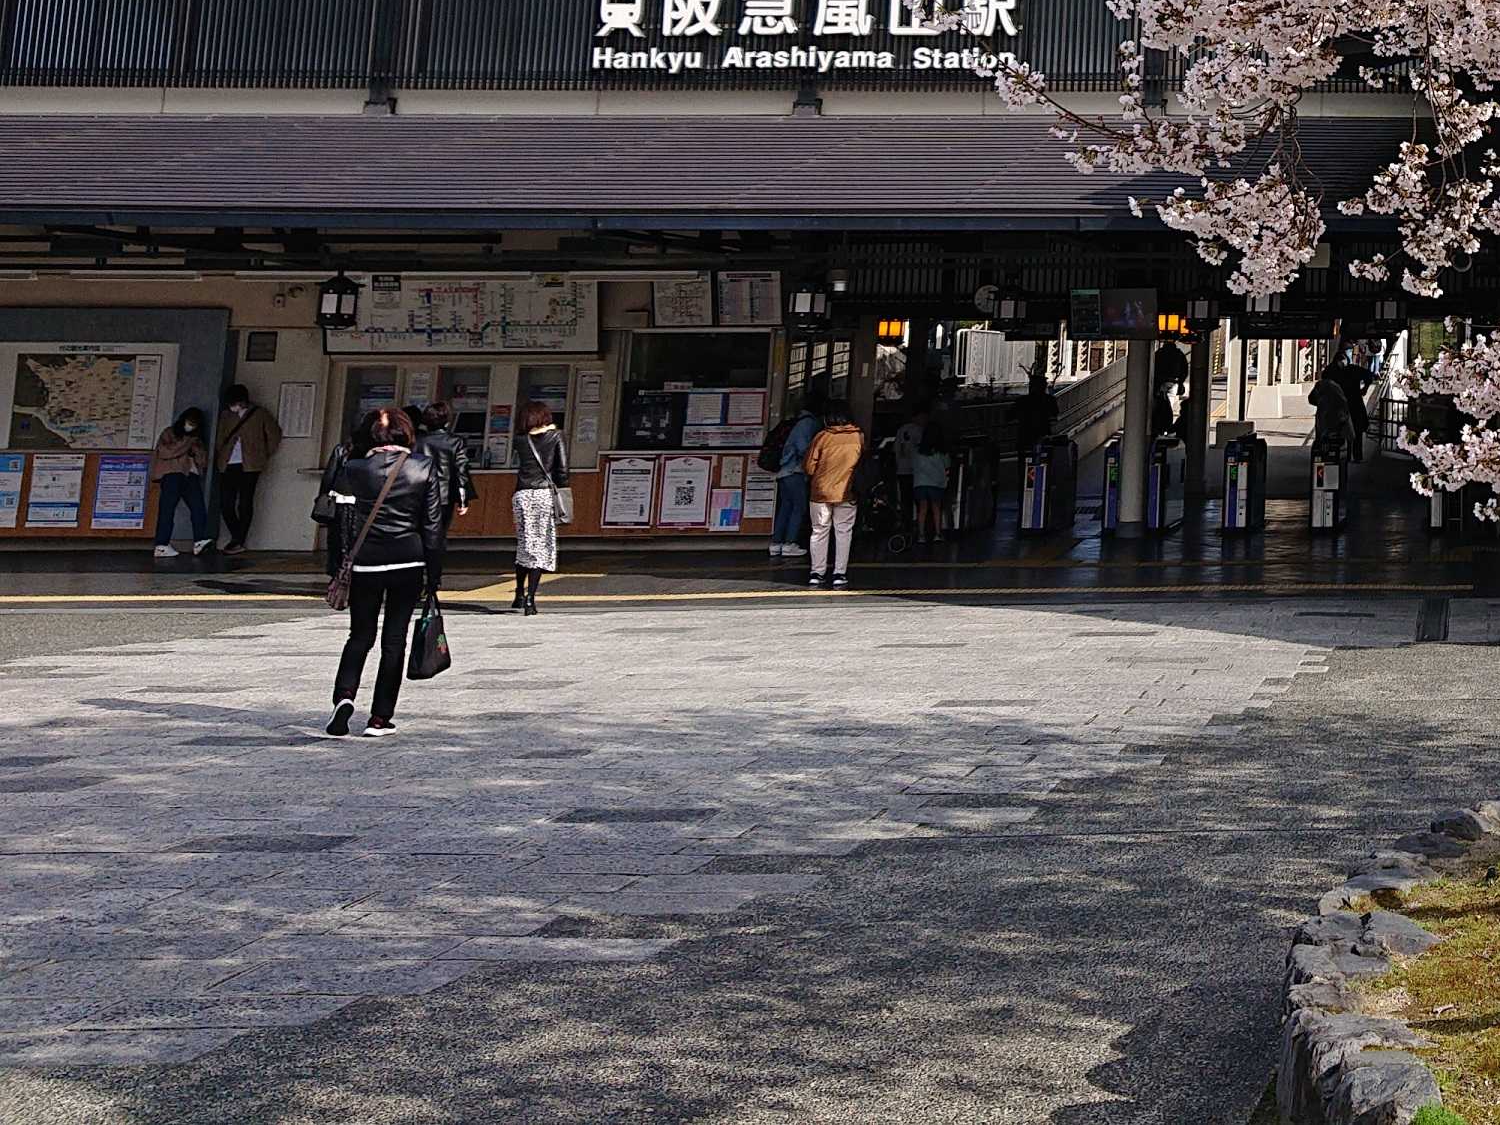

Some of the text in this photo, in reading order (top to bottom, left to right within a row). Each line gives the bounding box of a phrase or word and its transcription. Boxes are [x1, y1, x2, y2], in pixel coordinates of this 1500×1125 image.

[592, 46, 1018, 74] Hankyu Arashiyama Station
